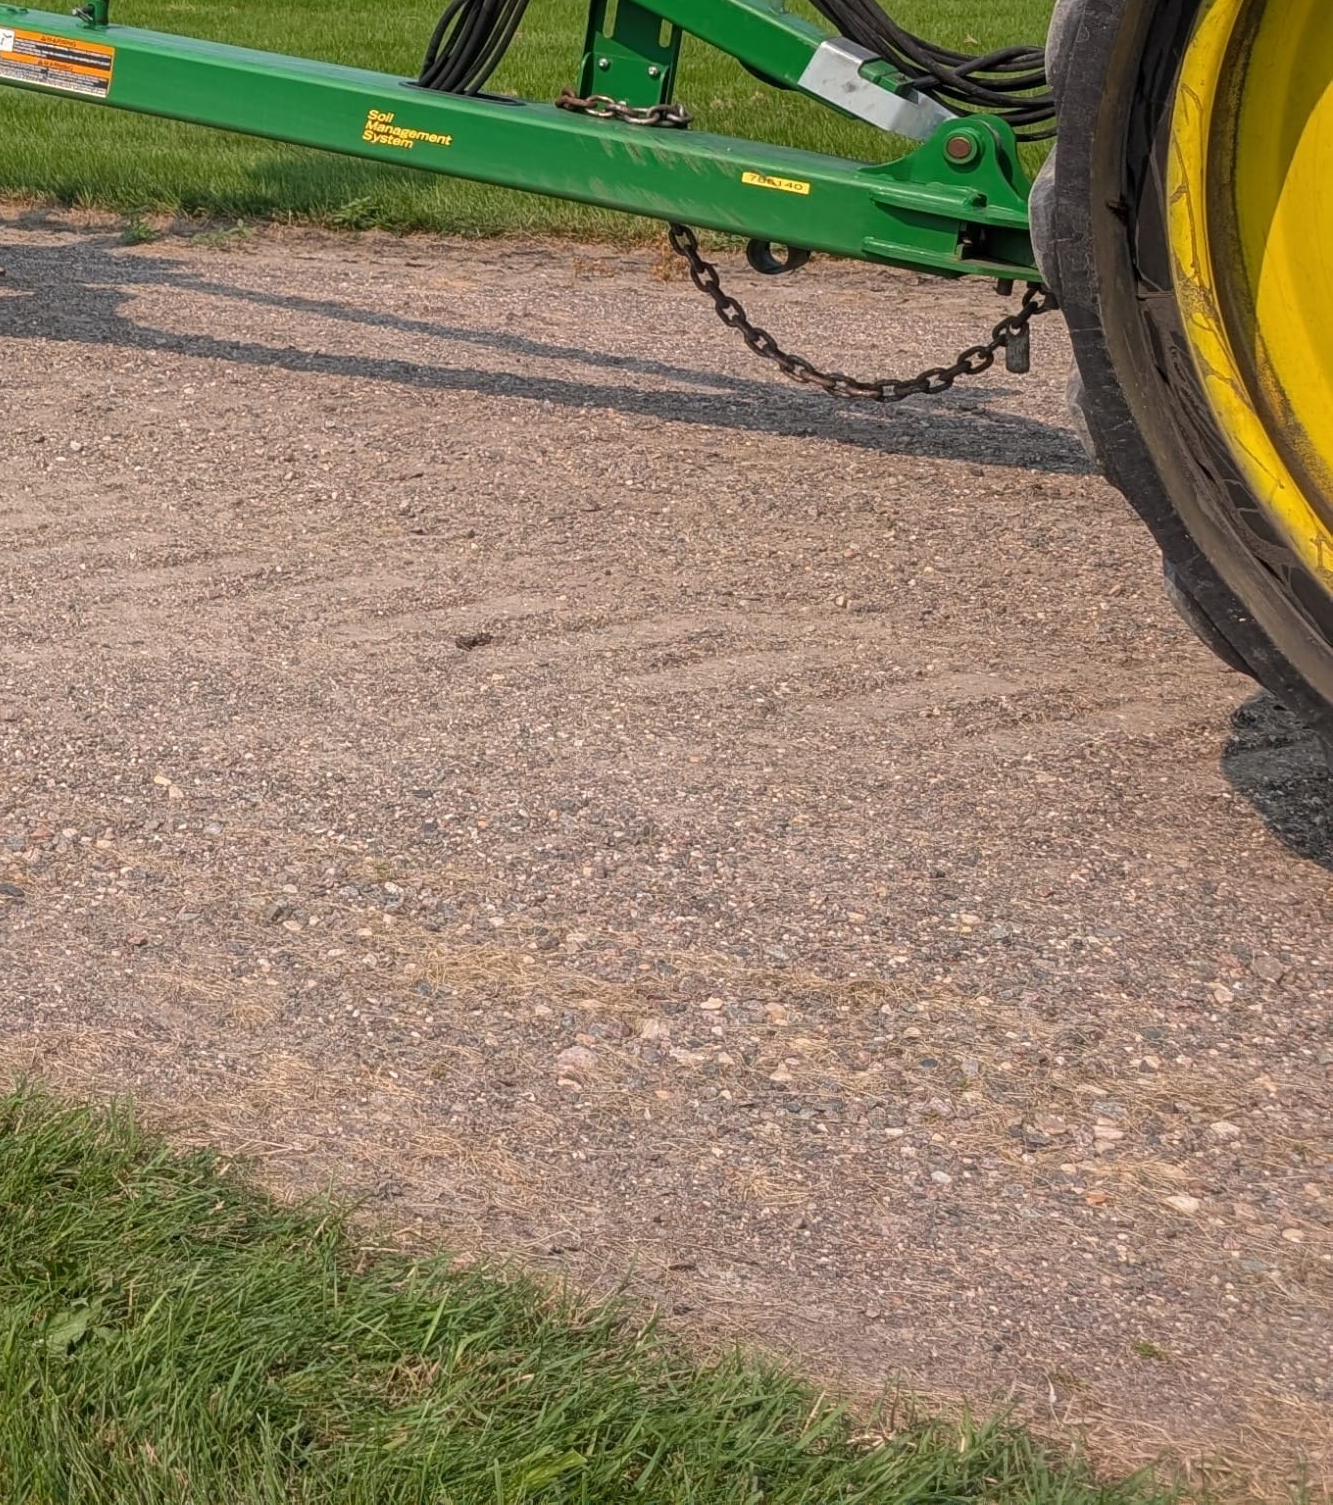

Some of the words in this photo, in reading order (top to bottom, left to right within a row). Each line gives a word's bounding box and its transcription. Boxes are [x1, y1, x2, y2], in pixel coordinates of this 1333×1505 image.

[367, 109, 394, 123] Soil
[362, 129, 414, 149] System
[364, 120, 453, 146] Management
